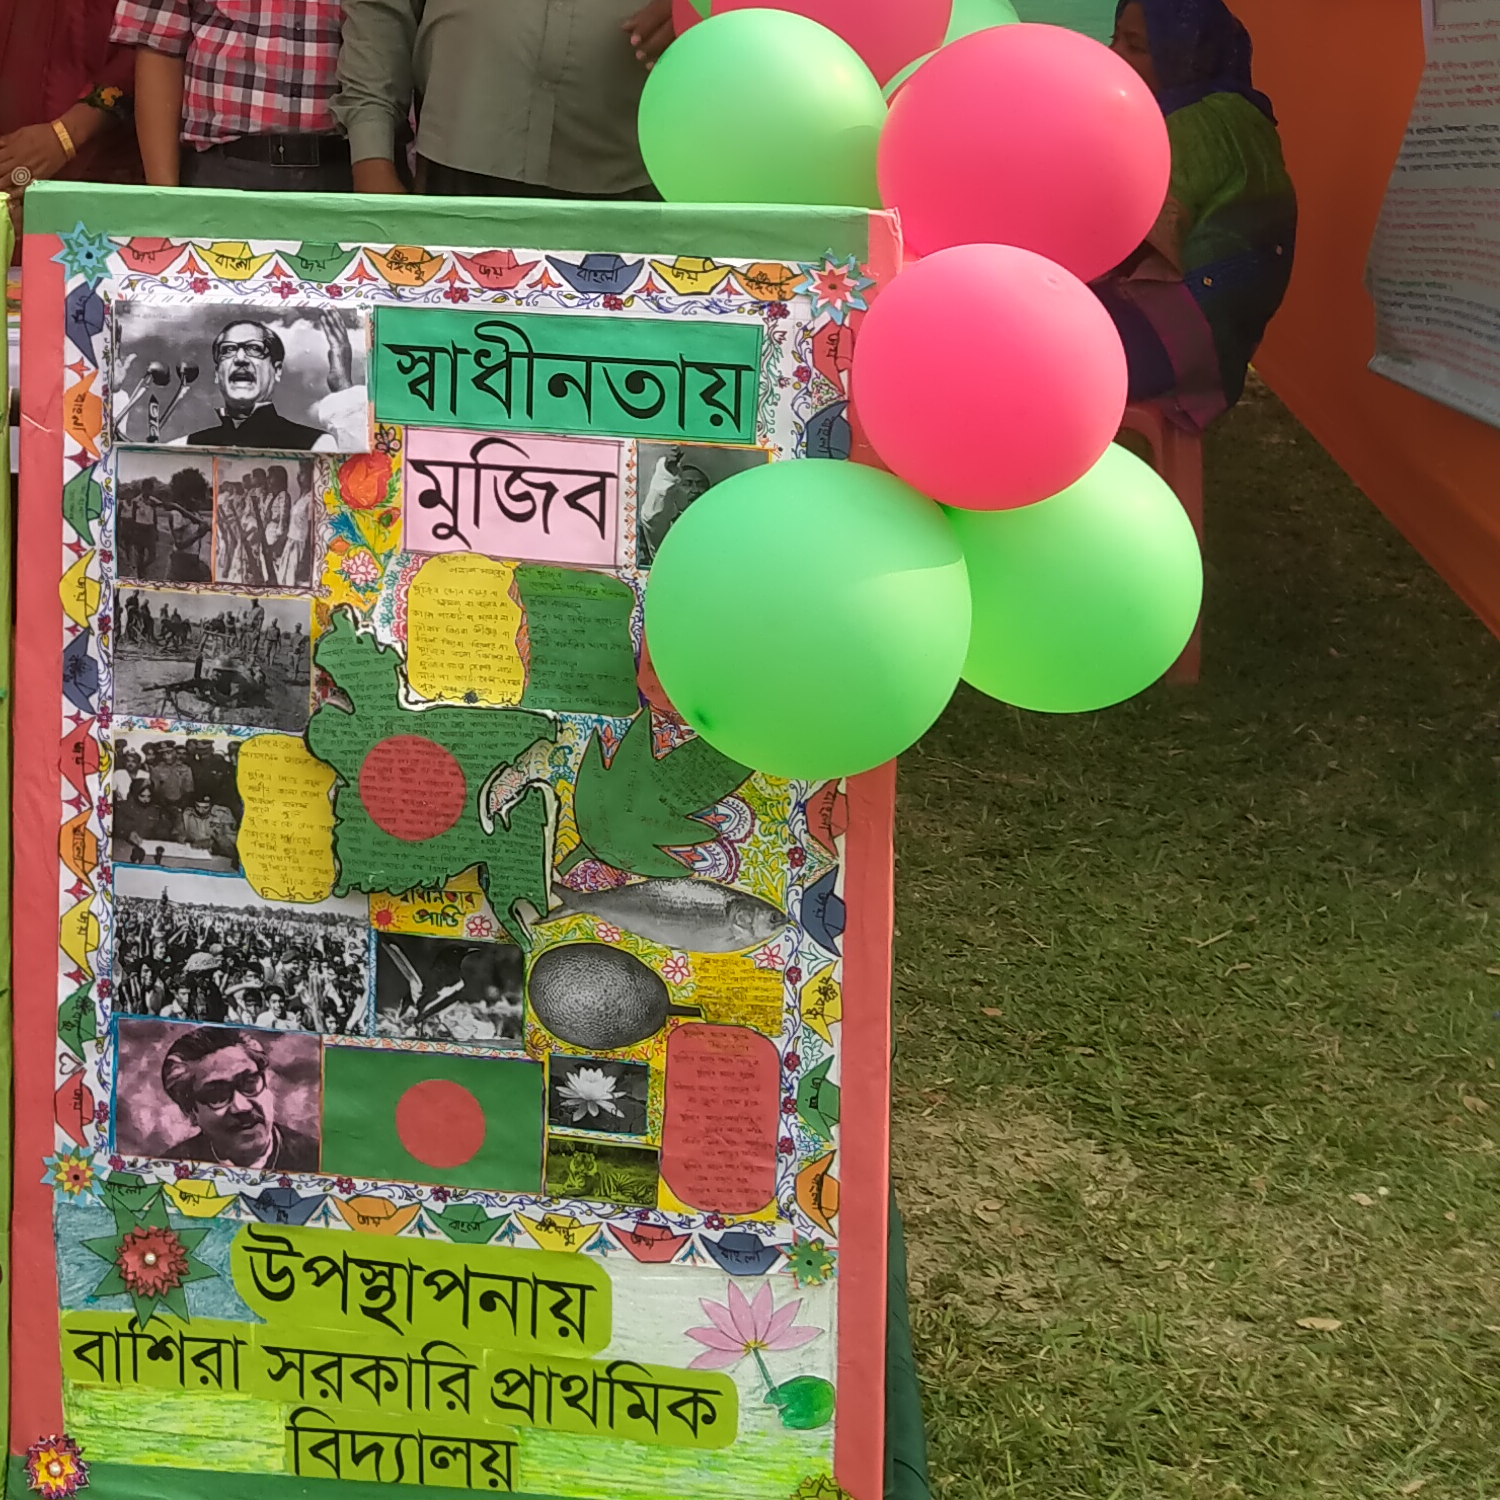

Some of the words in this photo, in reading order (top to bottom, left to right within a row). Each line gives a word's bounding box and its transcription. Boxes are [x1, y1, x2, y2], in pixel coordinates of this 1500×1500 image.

[382, 321, 754, 433] স্বাধীনতায়
[409, 437, 618, 550] মুজিব
[243, 1223, 597, 1345] উপস্থাপনায়
[67, 1313, 248, 1391] বাশিরা
[261, 1338, 479, 1415] সরকারি
[489, 1359, 723, 1440] প্রাথমিক
[286, 1406, 519, 1493] বিদ্যালয়
